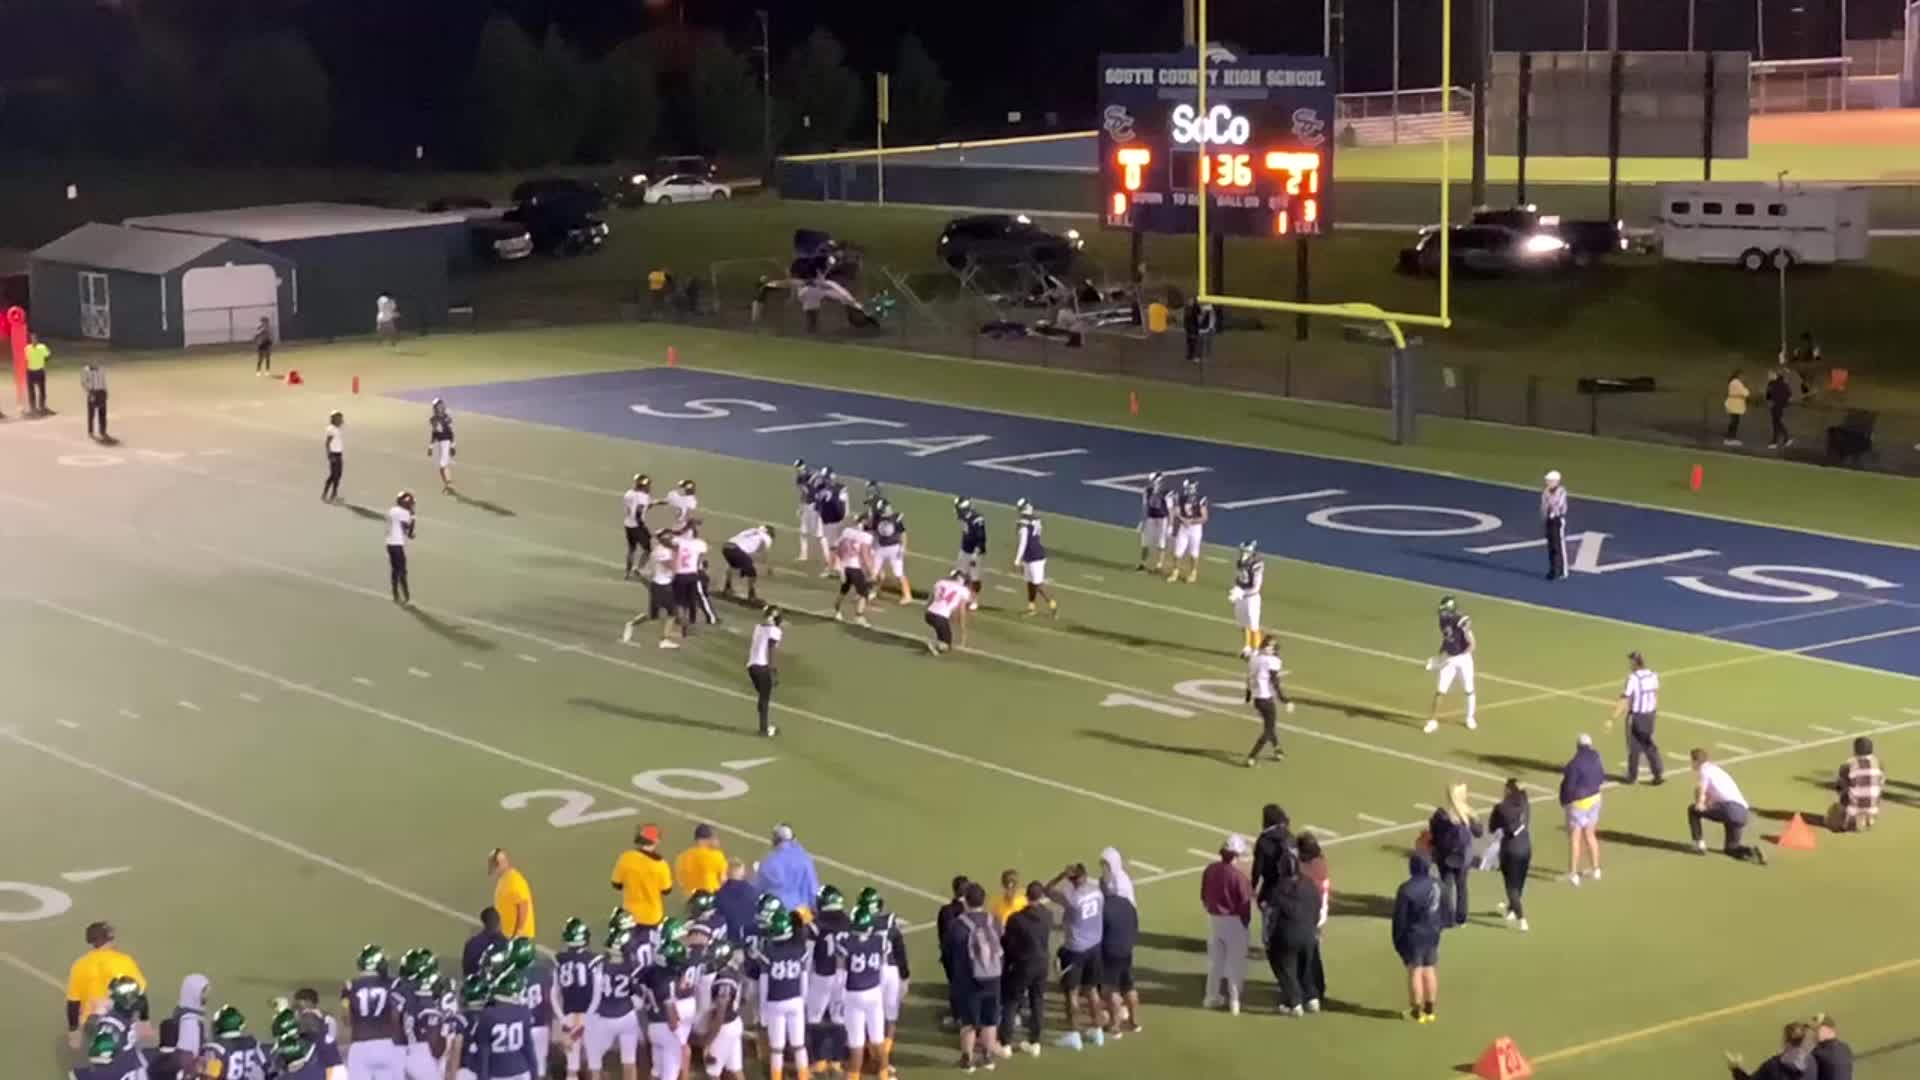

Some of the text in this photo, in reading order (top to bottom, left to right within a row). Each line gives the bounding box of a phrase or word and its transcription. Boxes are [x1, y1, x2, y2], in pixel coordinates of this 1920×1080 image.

[1105, 68, 1154, 85] SOUTH
[1224, 69, 1261, 86] HIGH
[1266, 70, 1326, 87] SCHOOL
[1172, 104, 1250, 145] SoCo
[629, 398, 1903, 604] STALLIONS
[501, 768, 749, 828] 20
[559, 961, 587, 987] 81
[850, 952, 880, 973] 84
[356, 987, 386, 1017] 17
[491, 1022, 524, 1053] 20
